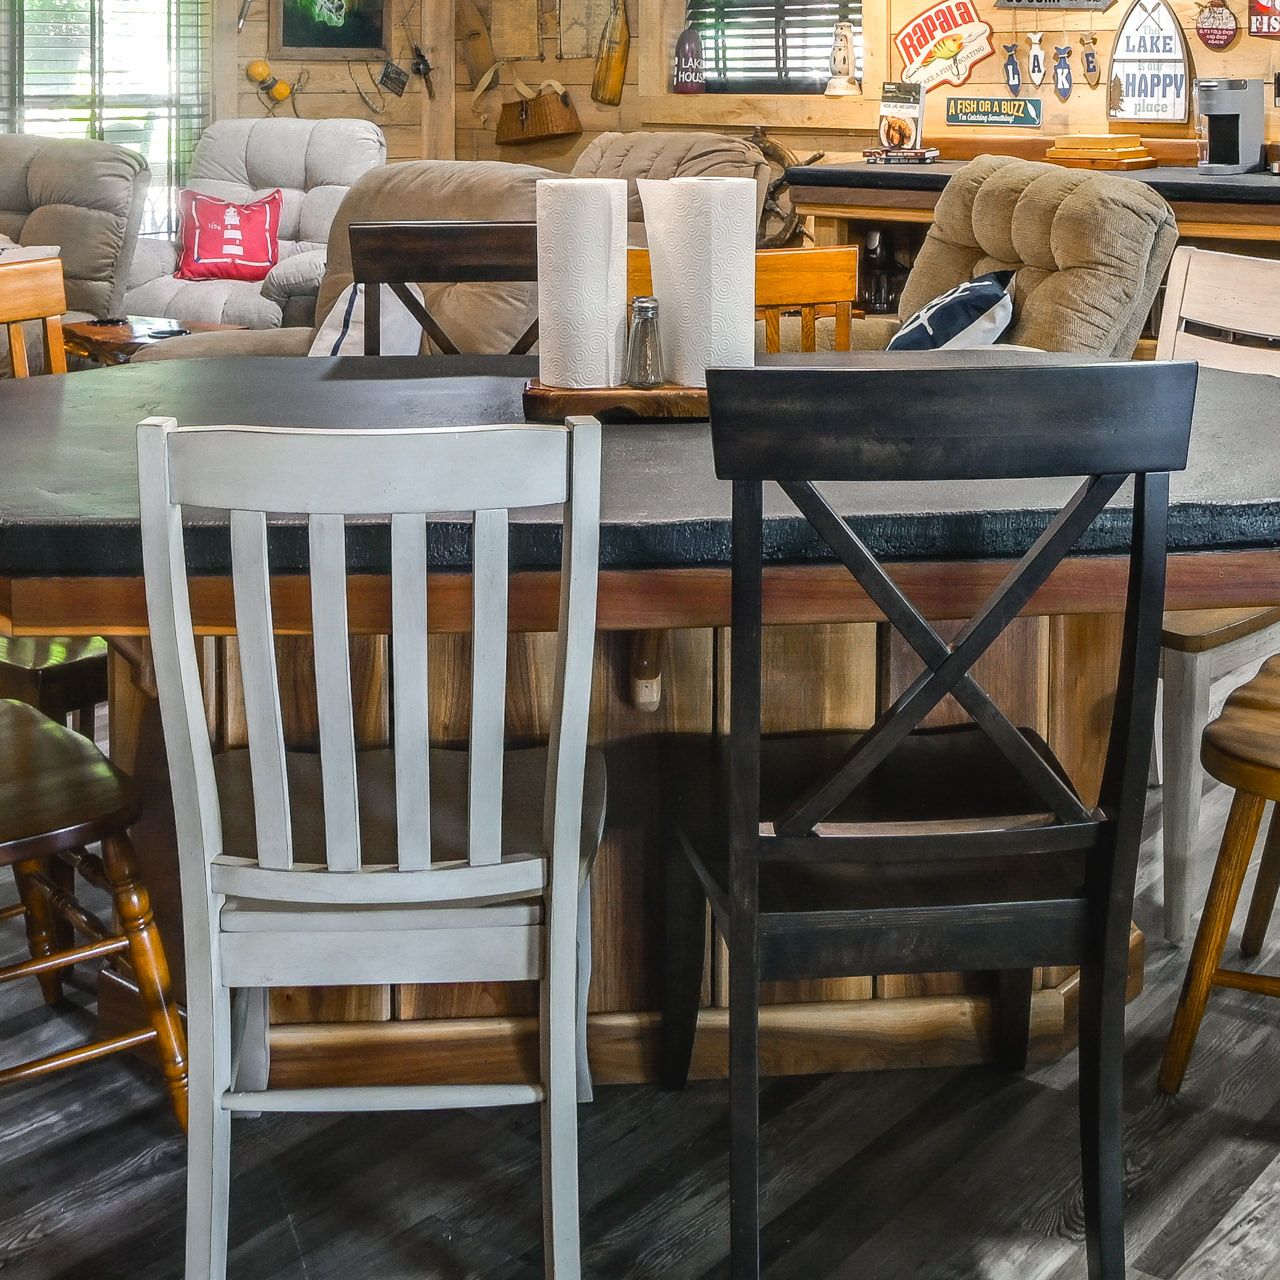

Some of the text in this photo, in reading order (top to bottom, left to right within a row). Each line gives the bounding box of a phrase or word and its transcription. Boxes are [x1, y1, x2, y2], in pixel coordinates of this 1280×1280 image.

[1125, 36, 1173, 53] LAKE
[958, 45, 985, 65] BOATING
[1125, 73, 1185, 98] HAPPY
[949, 100, 1025, 117] A FISH OR A BUZZ
[1134, 99, 1169, 115] place
[958, 113, 967, 121] I'm
[967, 114, 988, 123] Catching
